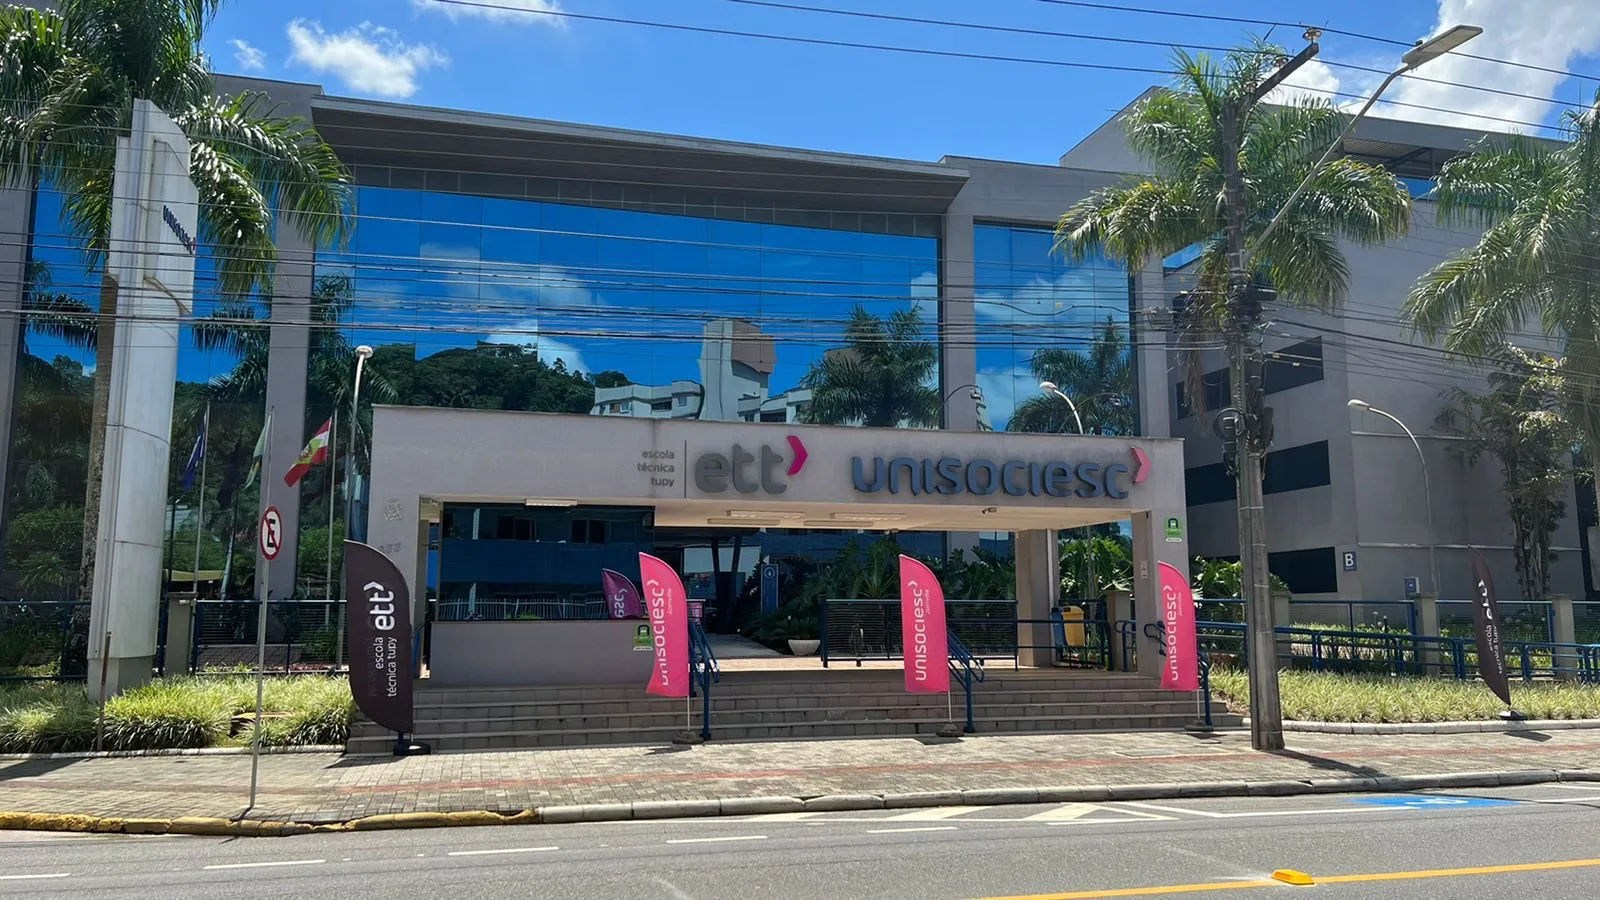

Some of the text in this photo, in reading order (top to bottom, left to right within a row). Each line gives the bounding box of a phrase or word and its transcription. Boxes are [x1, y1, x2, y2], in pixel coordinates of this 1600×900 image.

[637, 462, 675, 473] técnica
[642, 449, 675, 459] escola
[694, 443, 787, 494] ett
[651, 477, 675, 487] tupy
[852, 456, 1130, 499] unisociesc
[1344, 553, 1354, 566] B
[369, 590, 395, 630] ett
[373, 637, 384, 669] escola
[652, 587, 669, 686] unisociesc
[913, 588, 927, 681] unisociesc
[1167, 592, 1179, 681] unisociesc
[387, 637, 398, 697] técnica tupy
